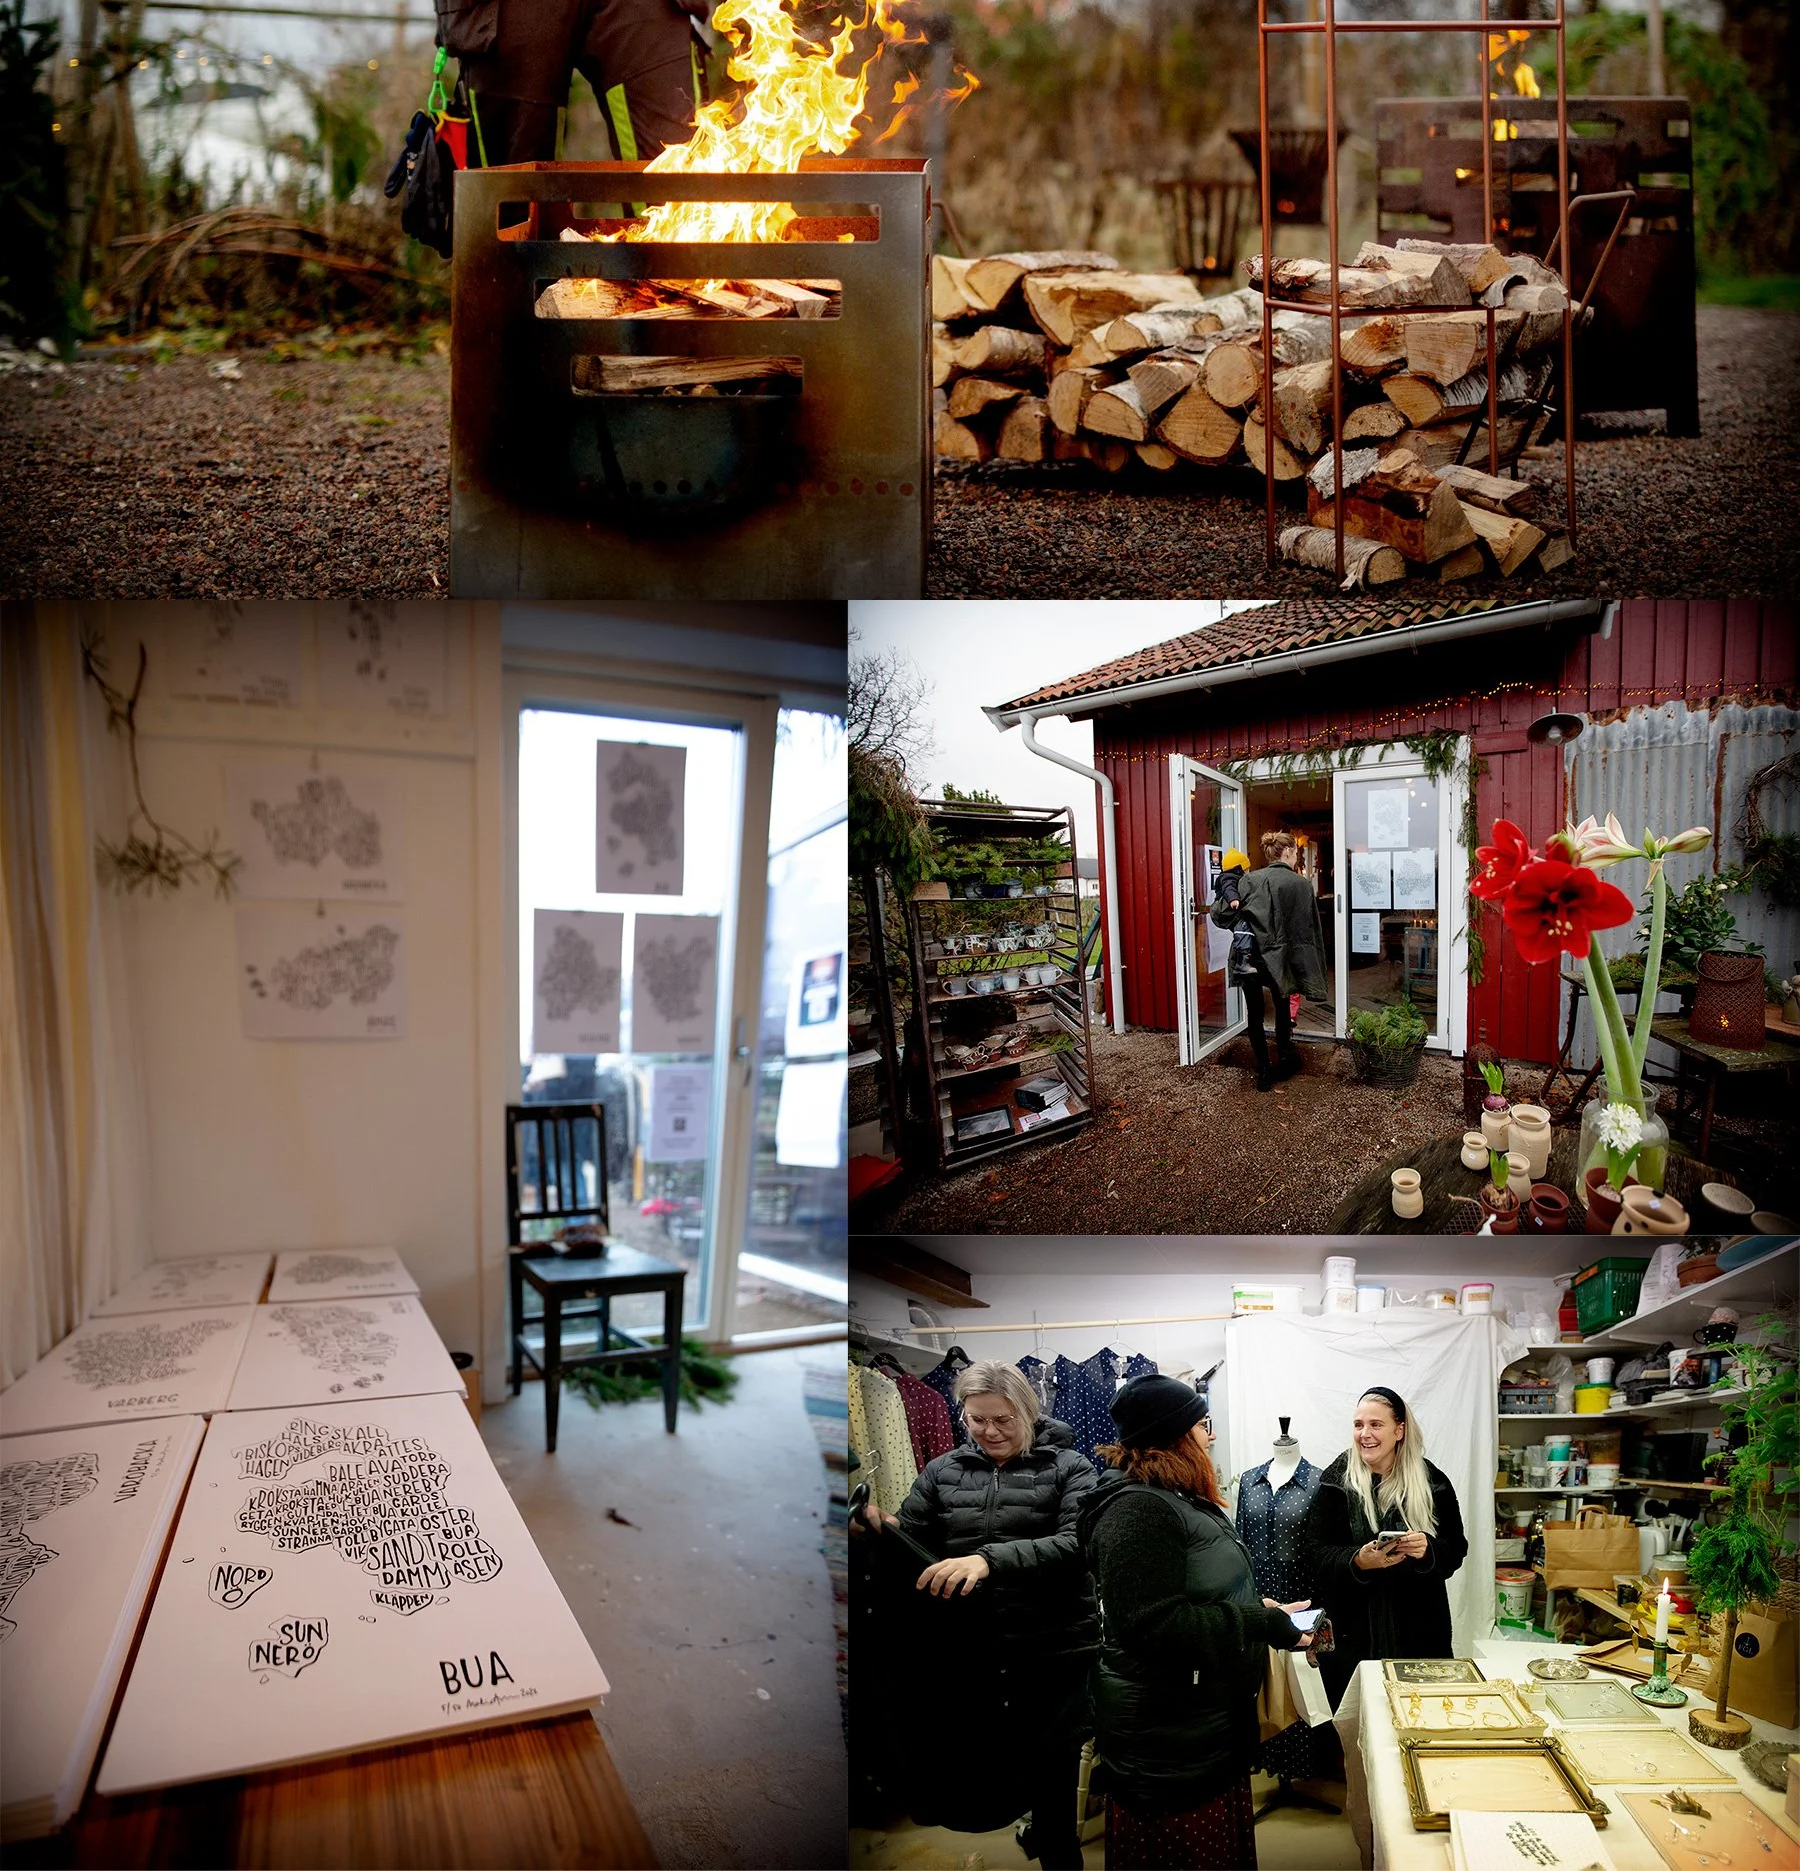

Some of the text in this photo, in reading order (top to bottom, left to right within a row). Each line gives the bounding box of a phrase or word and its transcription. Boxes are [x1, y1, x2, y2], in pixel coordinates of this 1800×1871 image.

[290, 1419, 329, 1436] RING
[281, 1432, 321, 1447] HALS
[245, 1439, 300, 1460] BISKOPS
[246, 1459, 289, 1478] HAGEN
[383, 1475, 440, 1501] NEREBY
[355, 1489, 380, 1507] BUA
[240, 1509, 273, 1521] GETA
[373, 1503, 397, 1519] BUA
[401, 1501, 441, 1518] KULLE
[420, 1508, 470, 1529] ÖSTER
[272, 1525, 328, 1537] SUNNER
[442, 1524, 474, 1540] BUA
[345, 1544, 365, 1559] VIK
[367, 1532, 424, 1570] SAND
[214, 1564, 267, 1591] NORD
[382, 1561, 446, 1588] DAMM
[375, 1593, 430, 1611] KLÄPPEN
[279, 1620, 324, 1646] SUN
[255, 1641, 315, 1666] NERÖ
[439, 1650, 515, 1695] BUA
